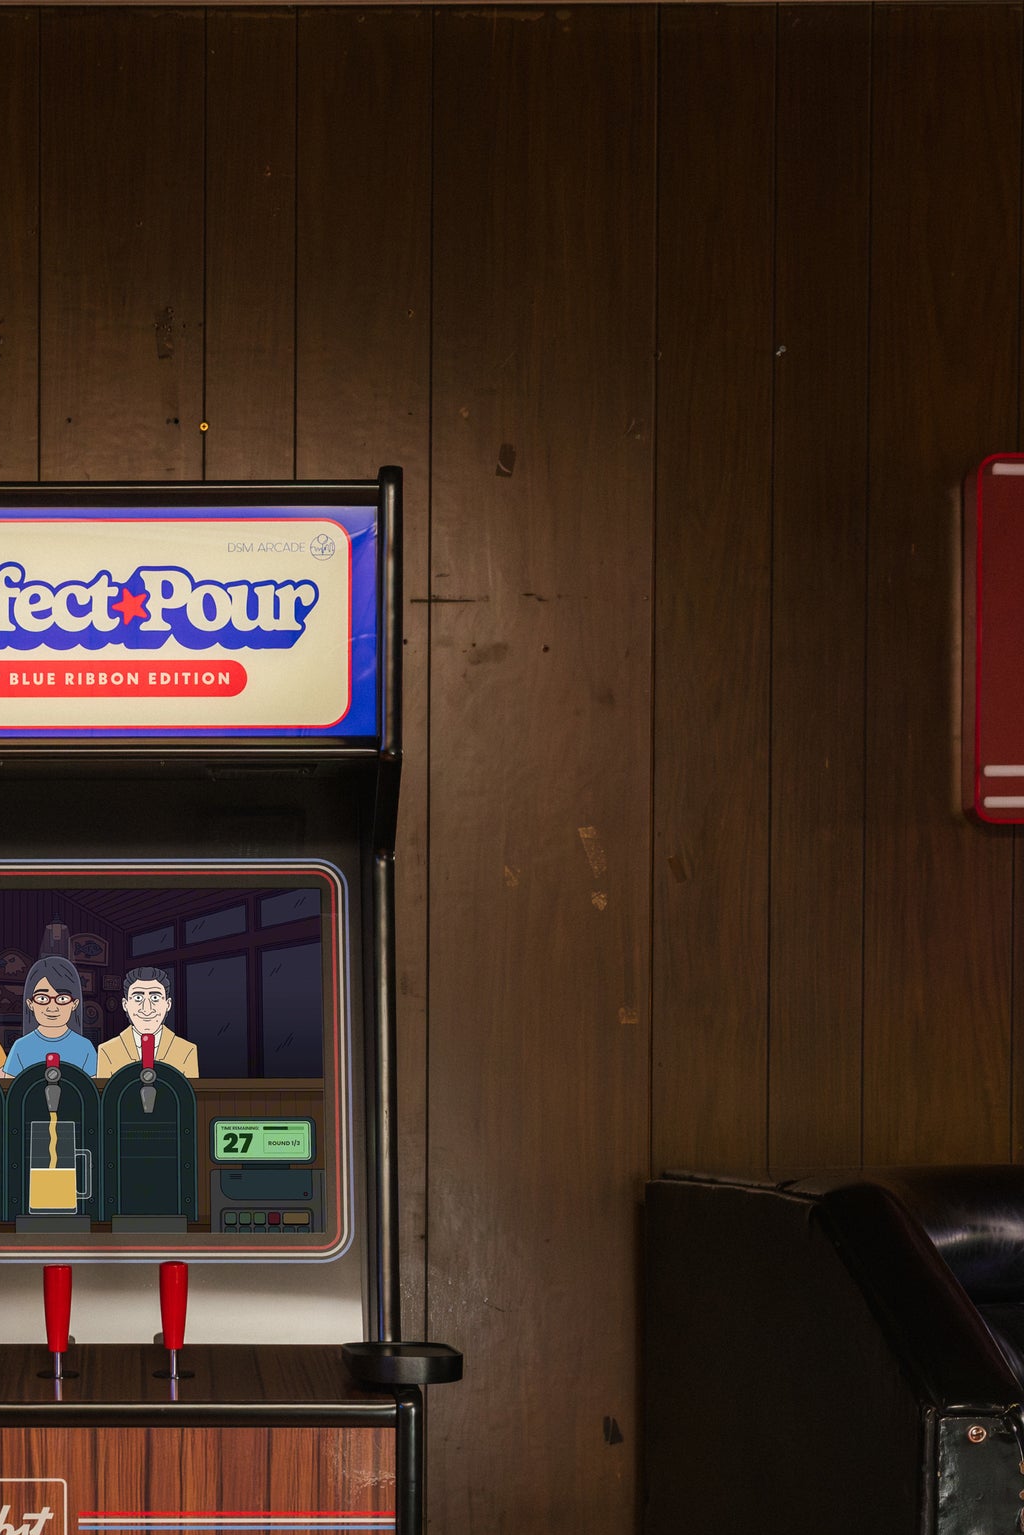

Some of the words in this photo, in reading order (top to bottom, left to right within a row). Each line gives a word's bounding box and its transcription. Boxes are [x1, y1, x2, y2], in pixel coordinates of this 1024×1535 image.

[227, 542, 254, 553] DSM
[257, 542, 306, 553] ARCADE
[139, 569, 320, 633] Pour
[9, 672, 56, 686] BLUE
[64, 672, 140, 686] RIBBON
[148, 671, 231, 685] EDITION
[222, 1132, 254, 1154] 27
